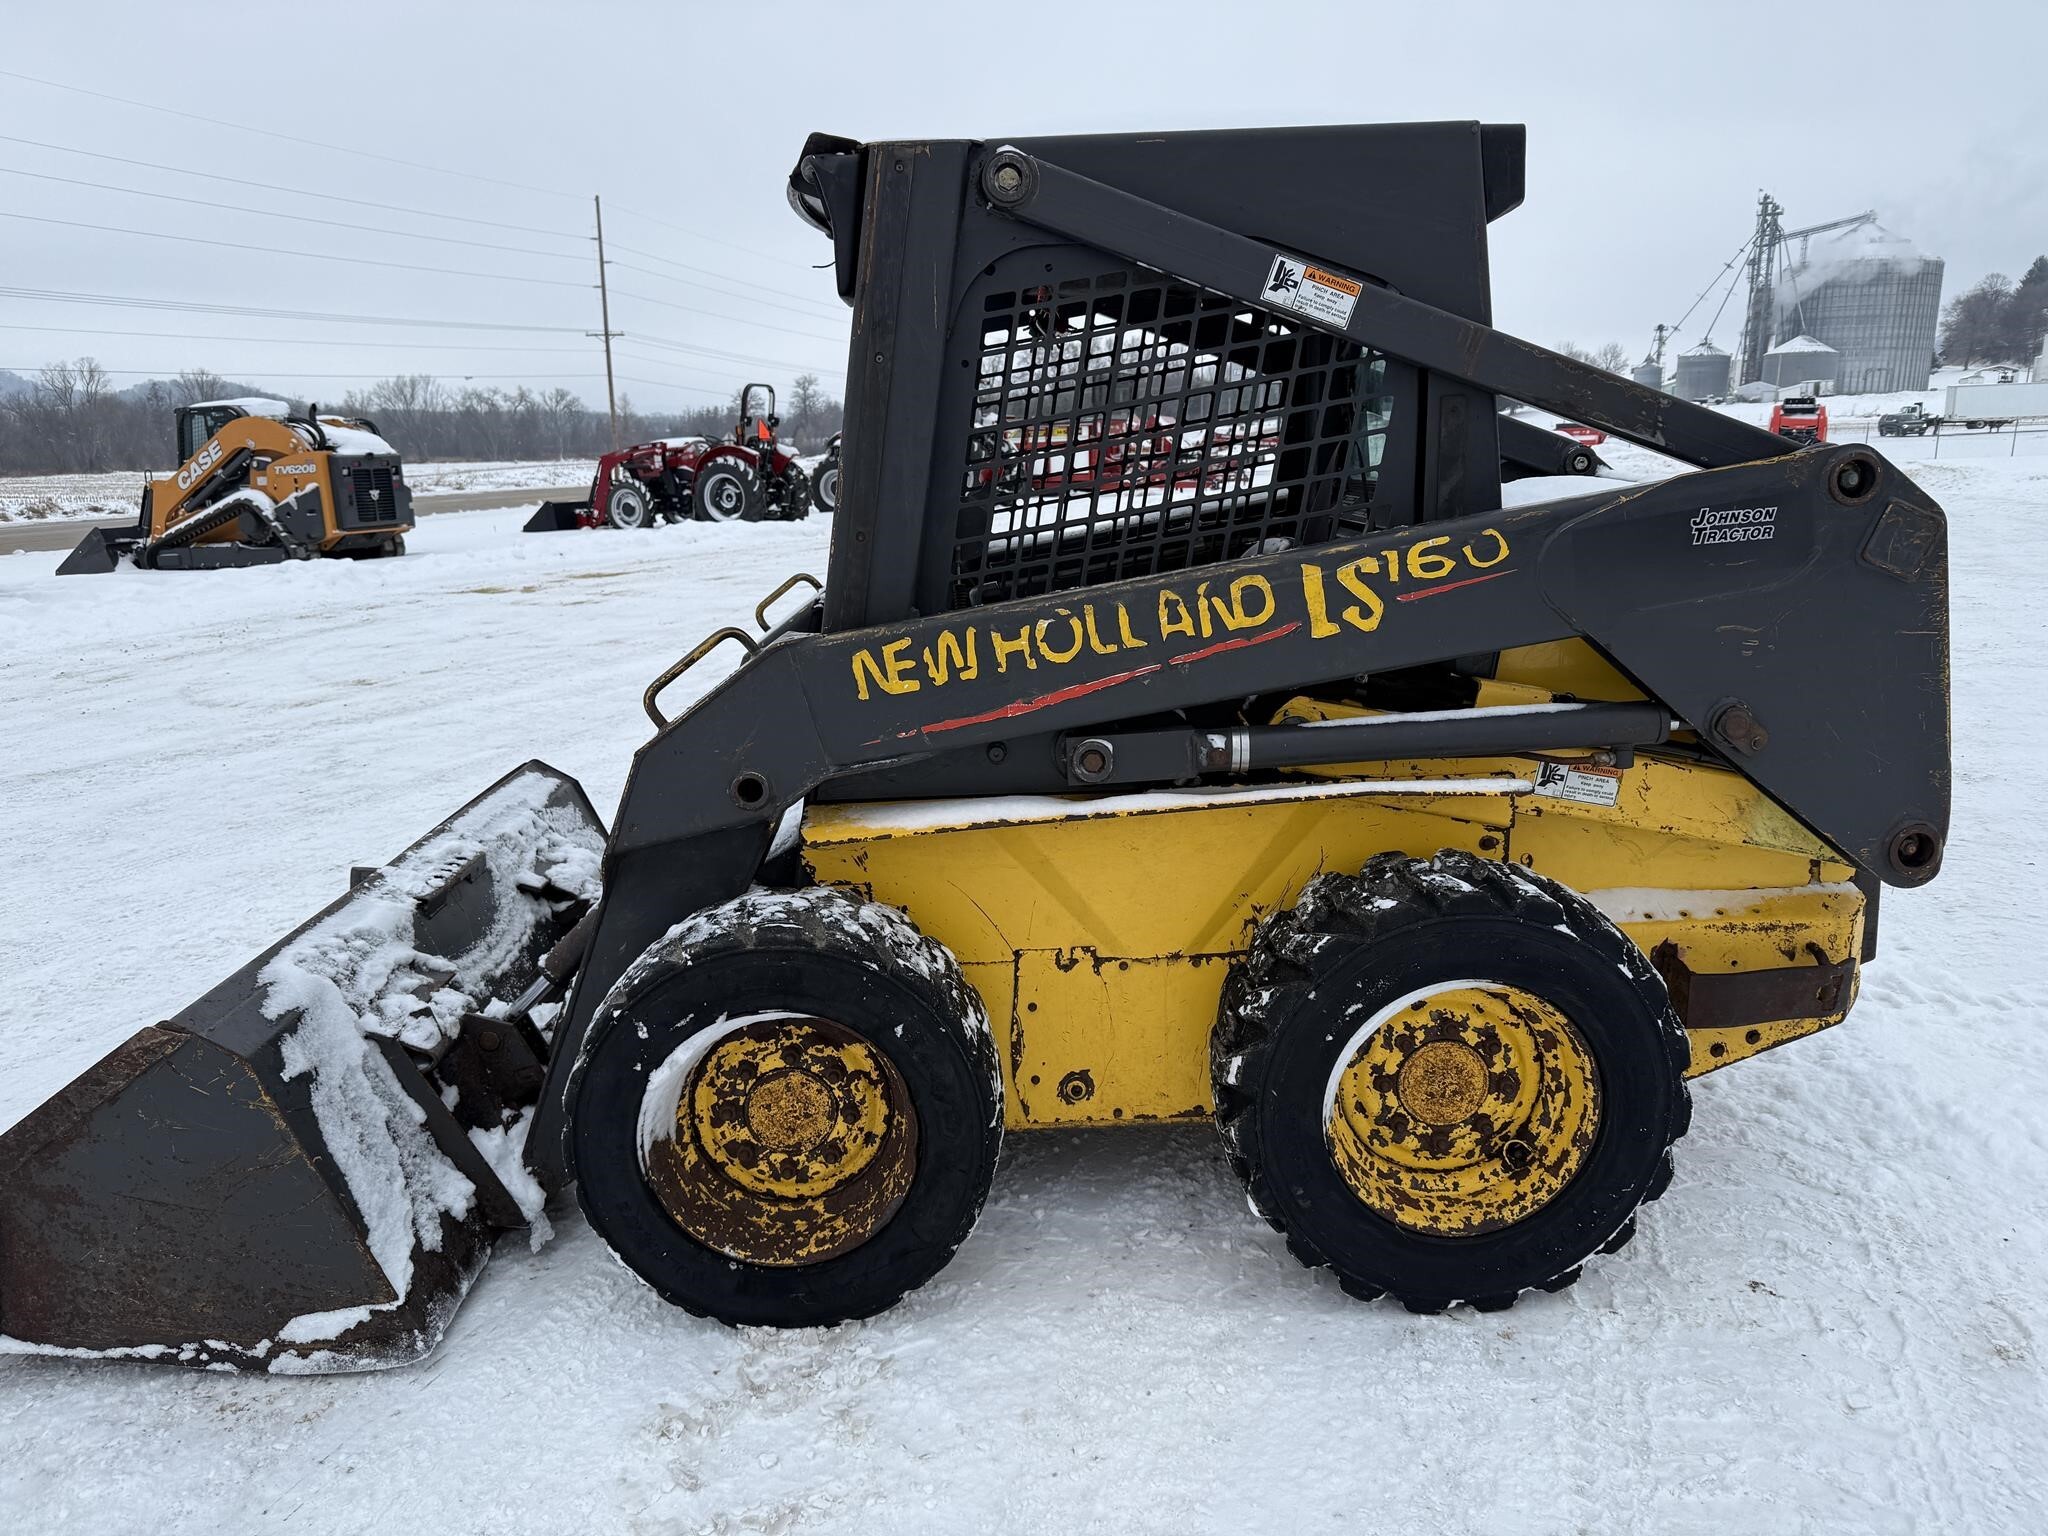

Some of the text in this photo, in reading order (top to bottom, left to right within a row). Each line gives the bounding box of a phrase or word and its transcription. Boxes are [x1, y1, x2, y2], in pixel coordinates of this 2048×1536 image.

[1311, 284, 1344, 300] PINCH AREA
[1318, 274, 1356, 292] WARNING
[177, 439, 223, 490] CASE
[274, 463, 317, 475] TV620B
[1691, 507, 1777, 528] JOHNSON
[1692, 525, 1775, 545] TRACTOR
[851, 625, 978, 700] NEW
[991, 573, 1276, 673] HOLLAND
[1582, 765, 1618, 776] WARNING
